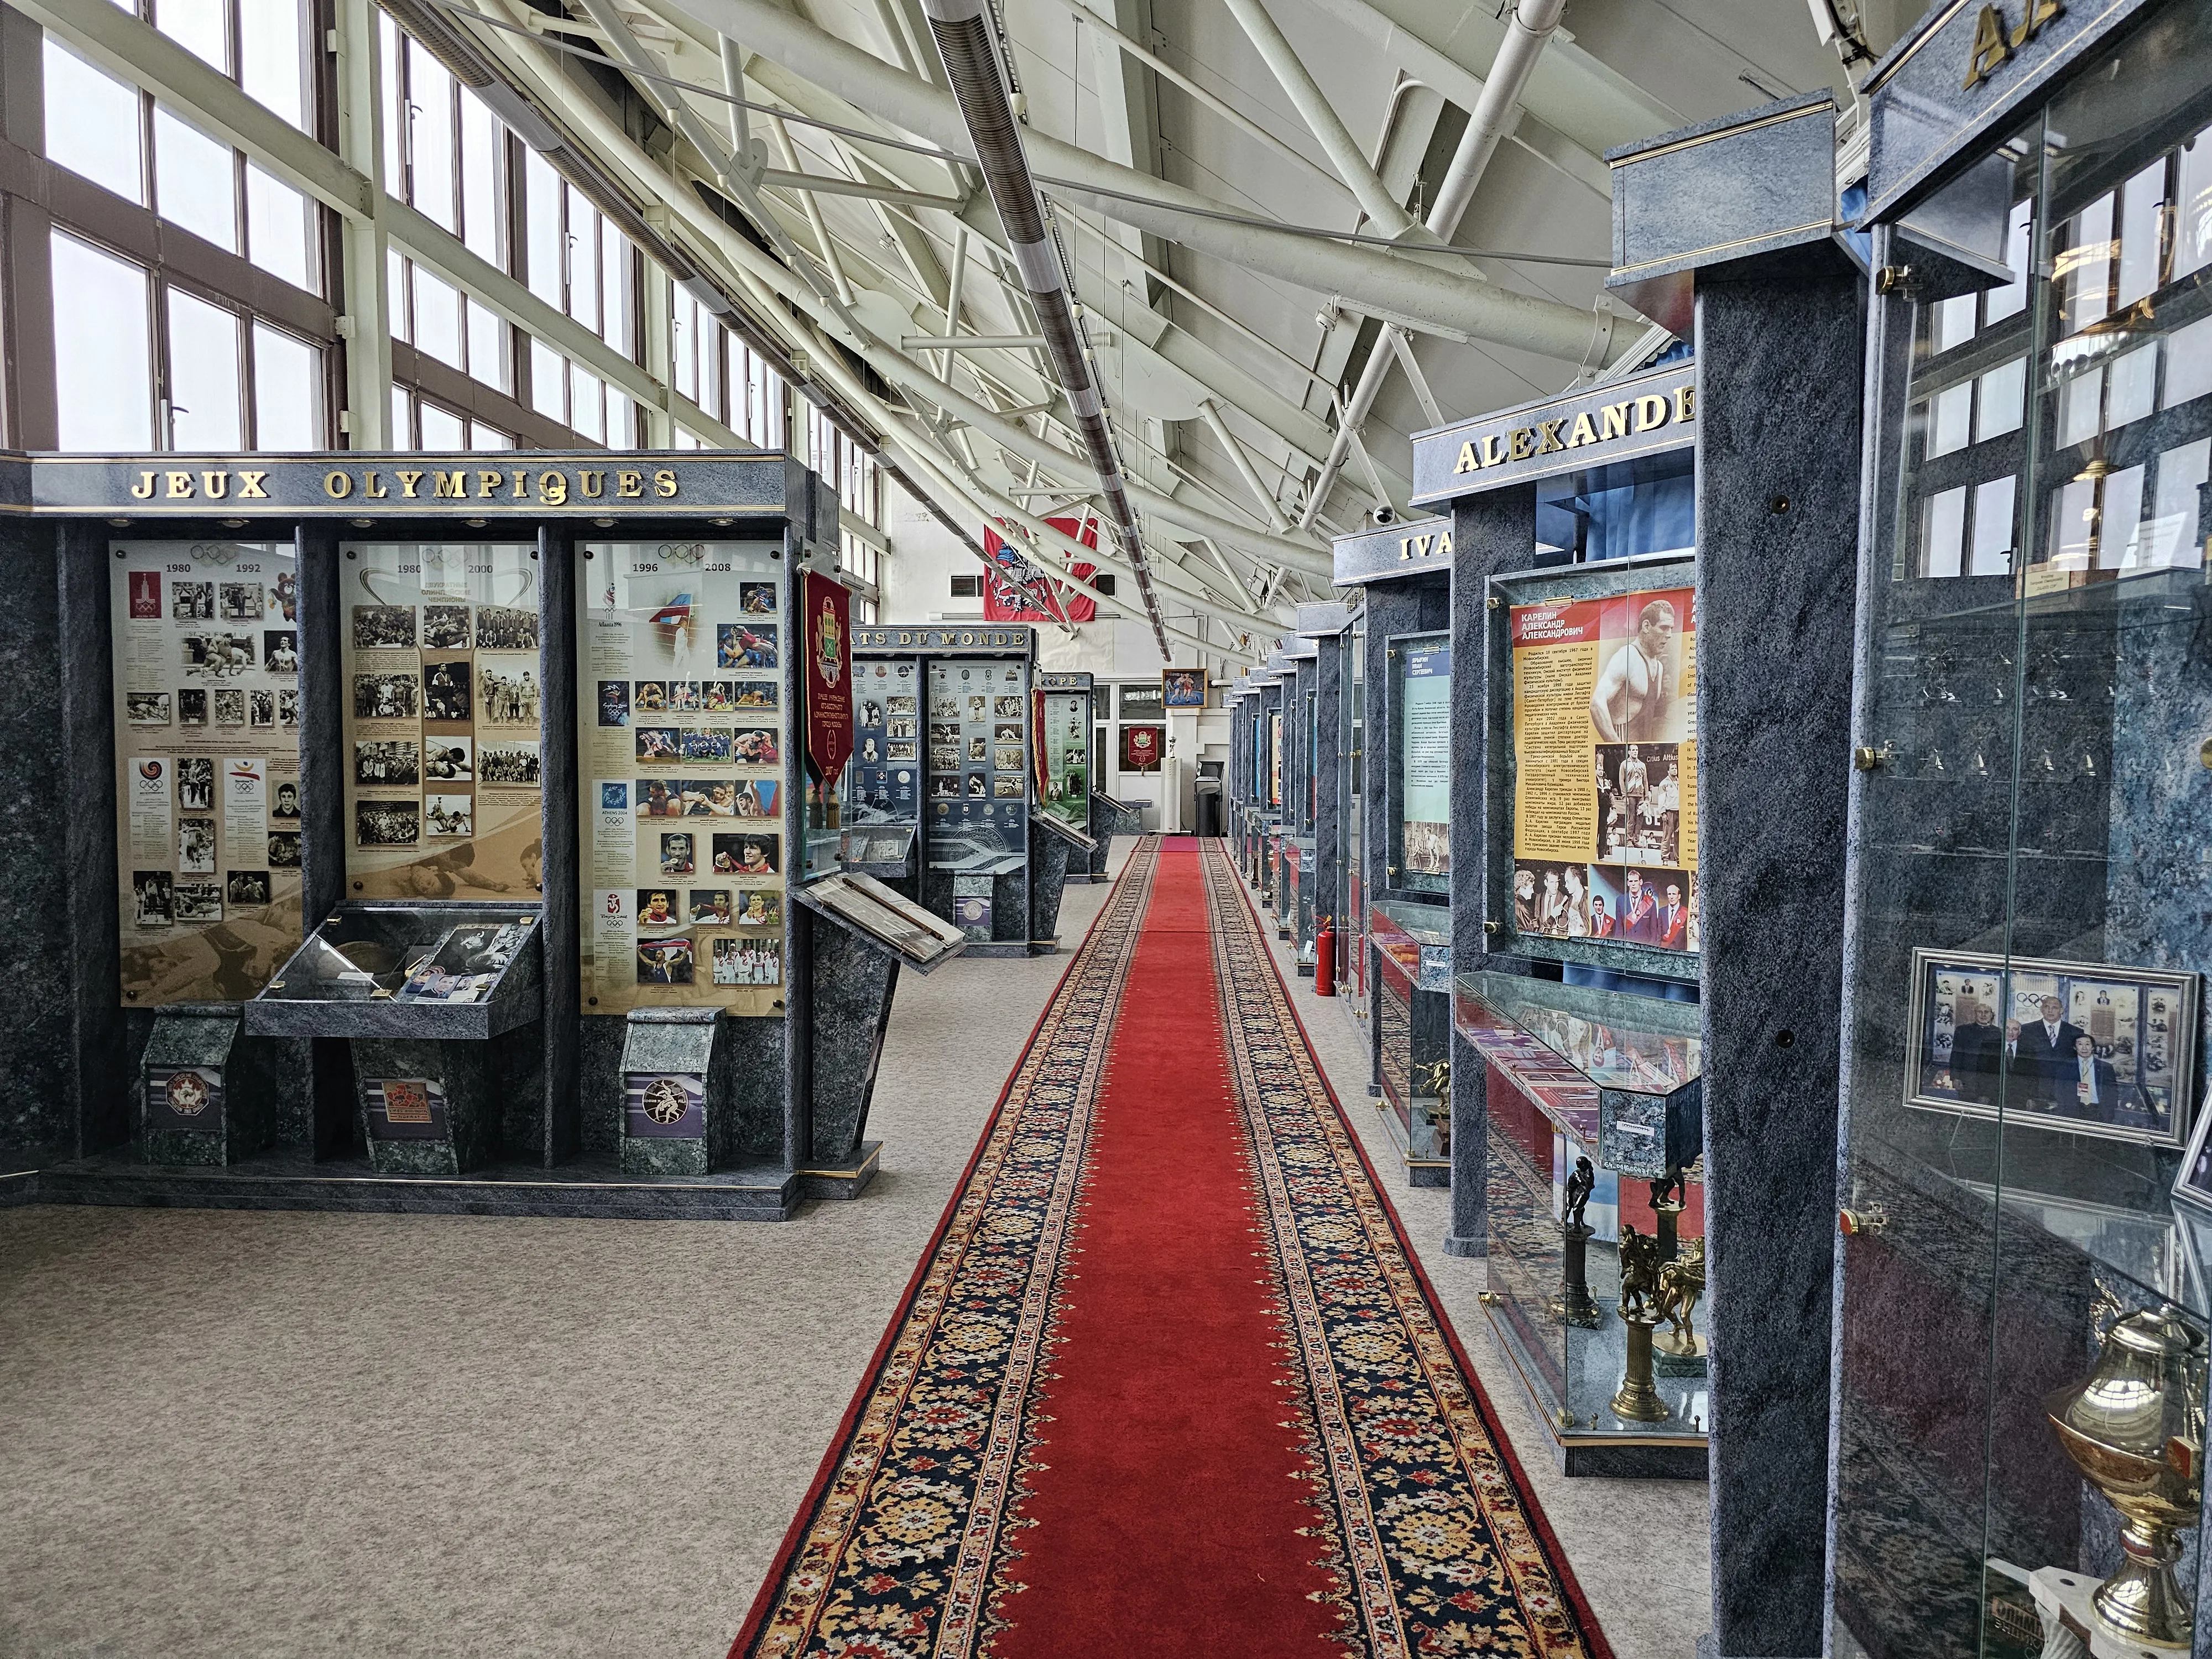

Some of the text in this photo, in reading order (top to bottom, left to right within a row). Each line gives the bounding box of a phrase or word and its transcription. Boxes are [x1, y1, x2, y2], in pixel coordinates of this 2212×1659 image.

[1453, 386, 1695, 474] ALEXANDE
[132, 470, 679, 505] JEUX OLYMPIQUES
[166, 564, 261, 572] 1980 1992
[398, 565, 493, 573] 1980 2000
[633, 563, 731, 572] 1996 2008
[1521, 611, 1557, 622] КАРЕЛИН
[1521, 619, 1565, 631] АЛЕКСАНДР
[899, 632, 928, 645] DU
[942, 633, 1025, 645] MONDE
[1522, 627, 1583, 640] АЛЕКСАНДРОВИЧ
